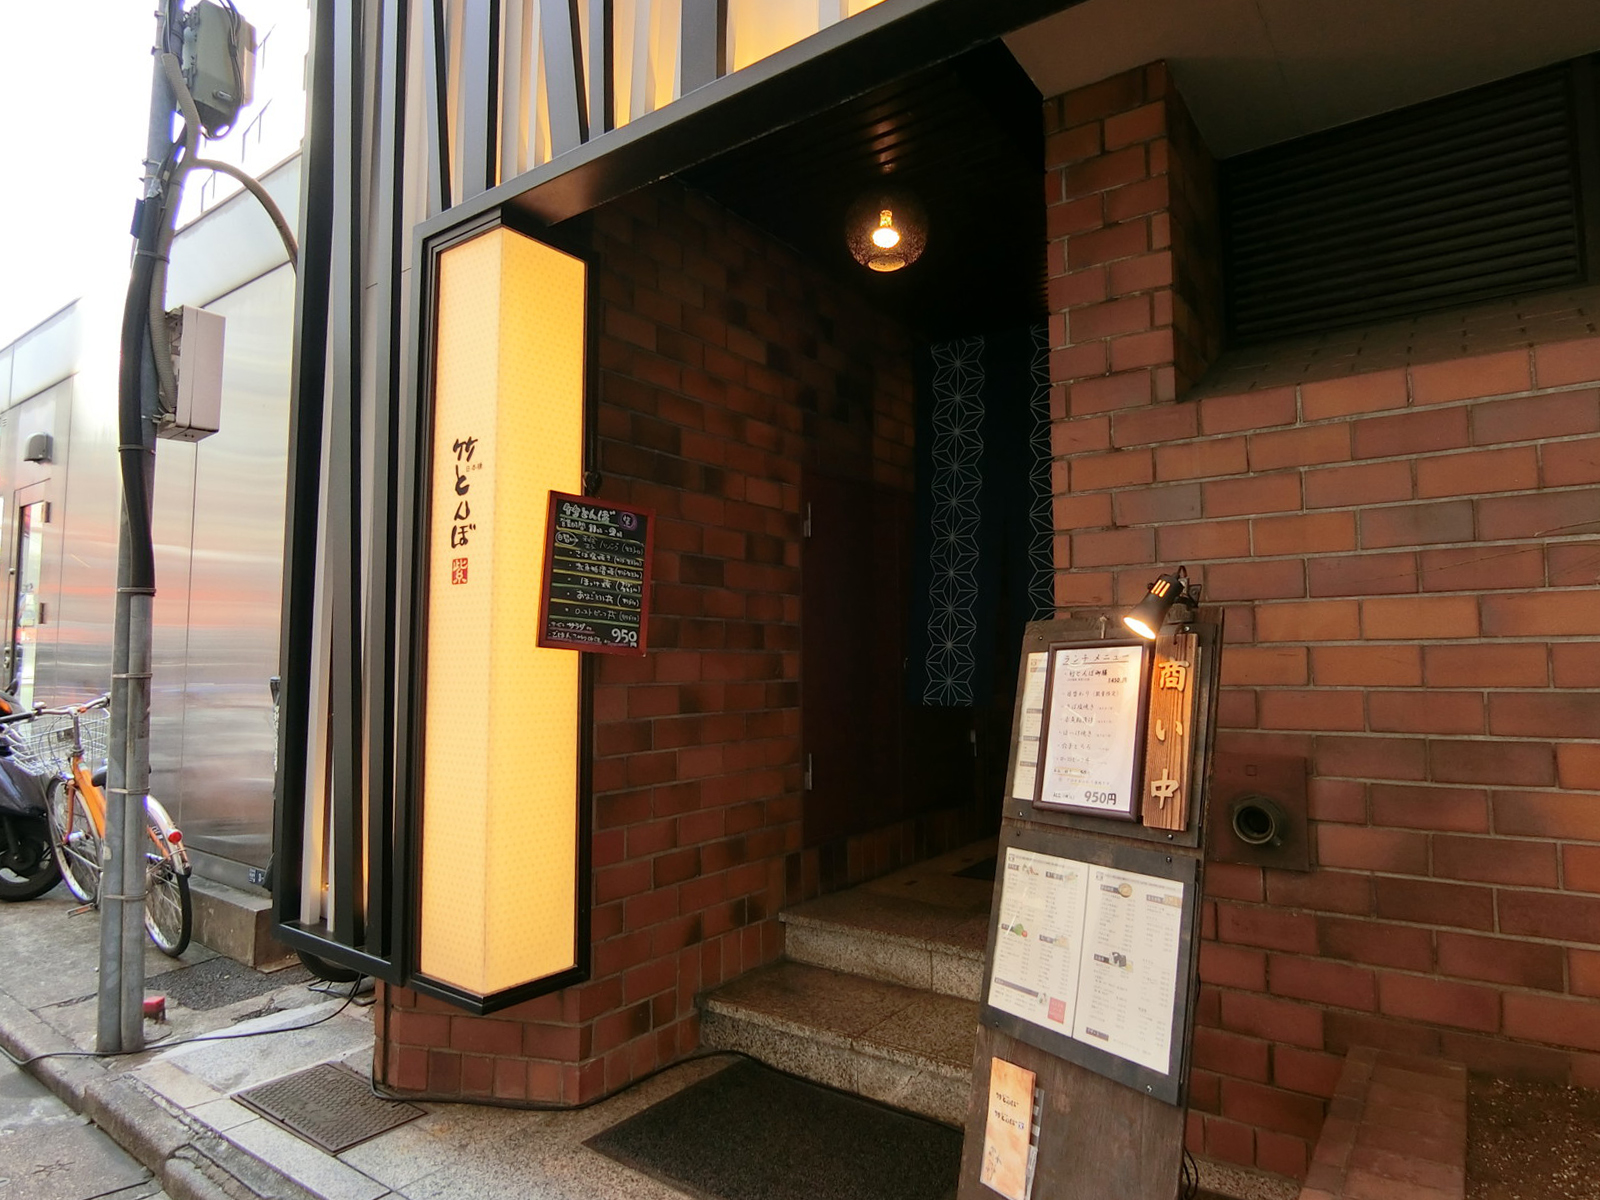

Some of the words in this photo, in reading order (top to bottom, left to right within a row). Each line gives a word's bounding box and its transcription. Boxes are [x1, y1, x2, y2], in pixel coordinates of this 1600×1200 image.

[451, 436, 478, 549] 竹とんぼ
[1150, 659, 1190, 810] 商い中
